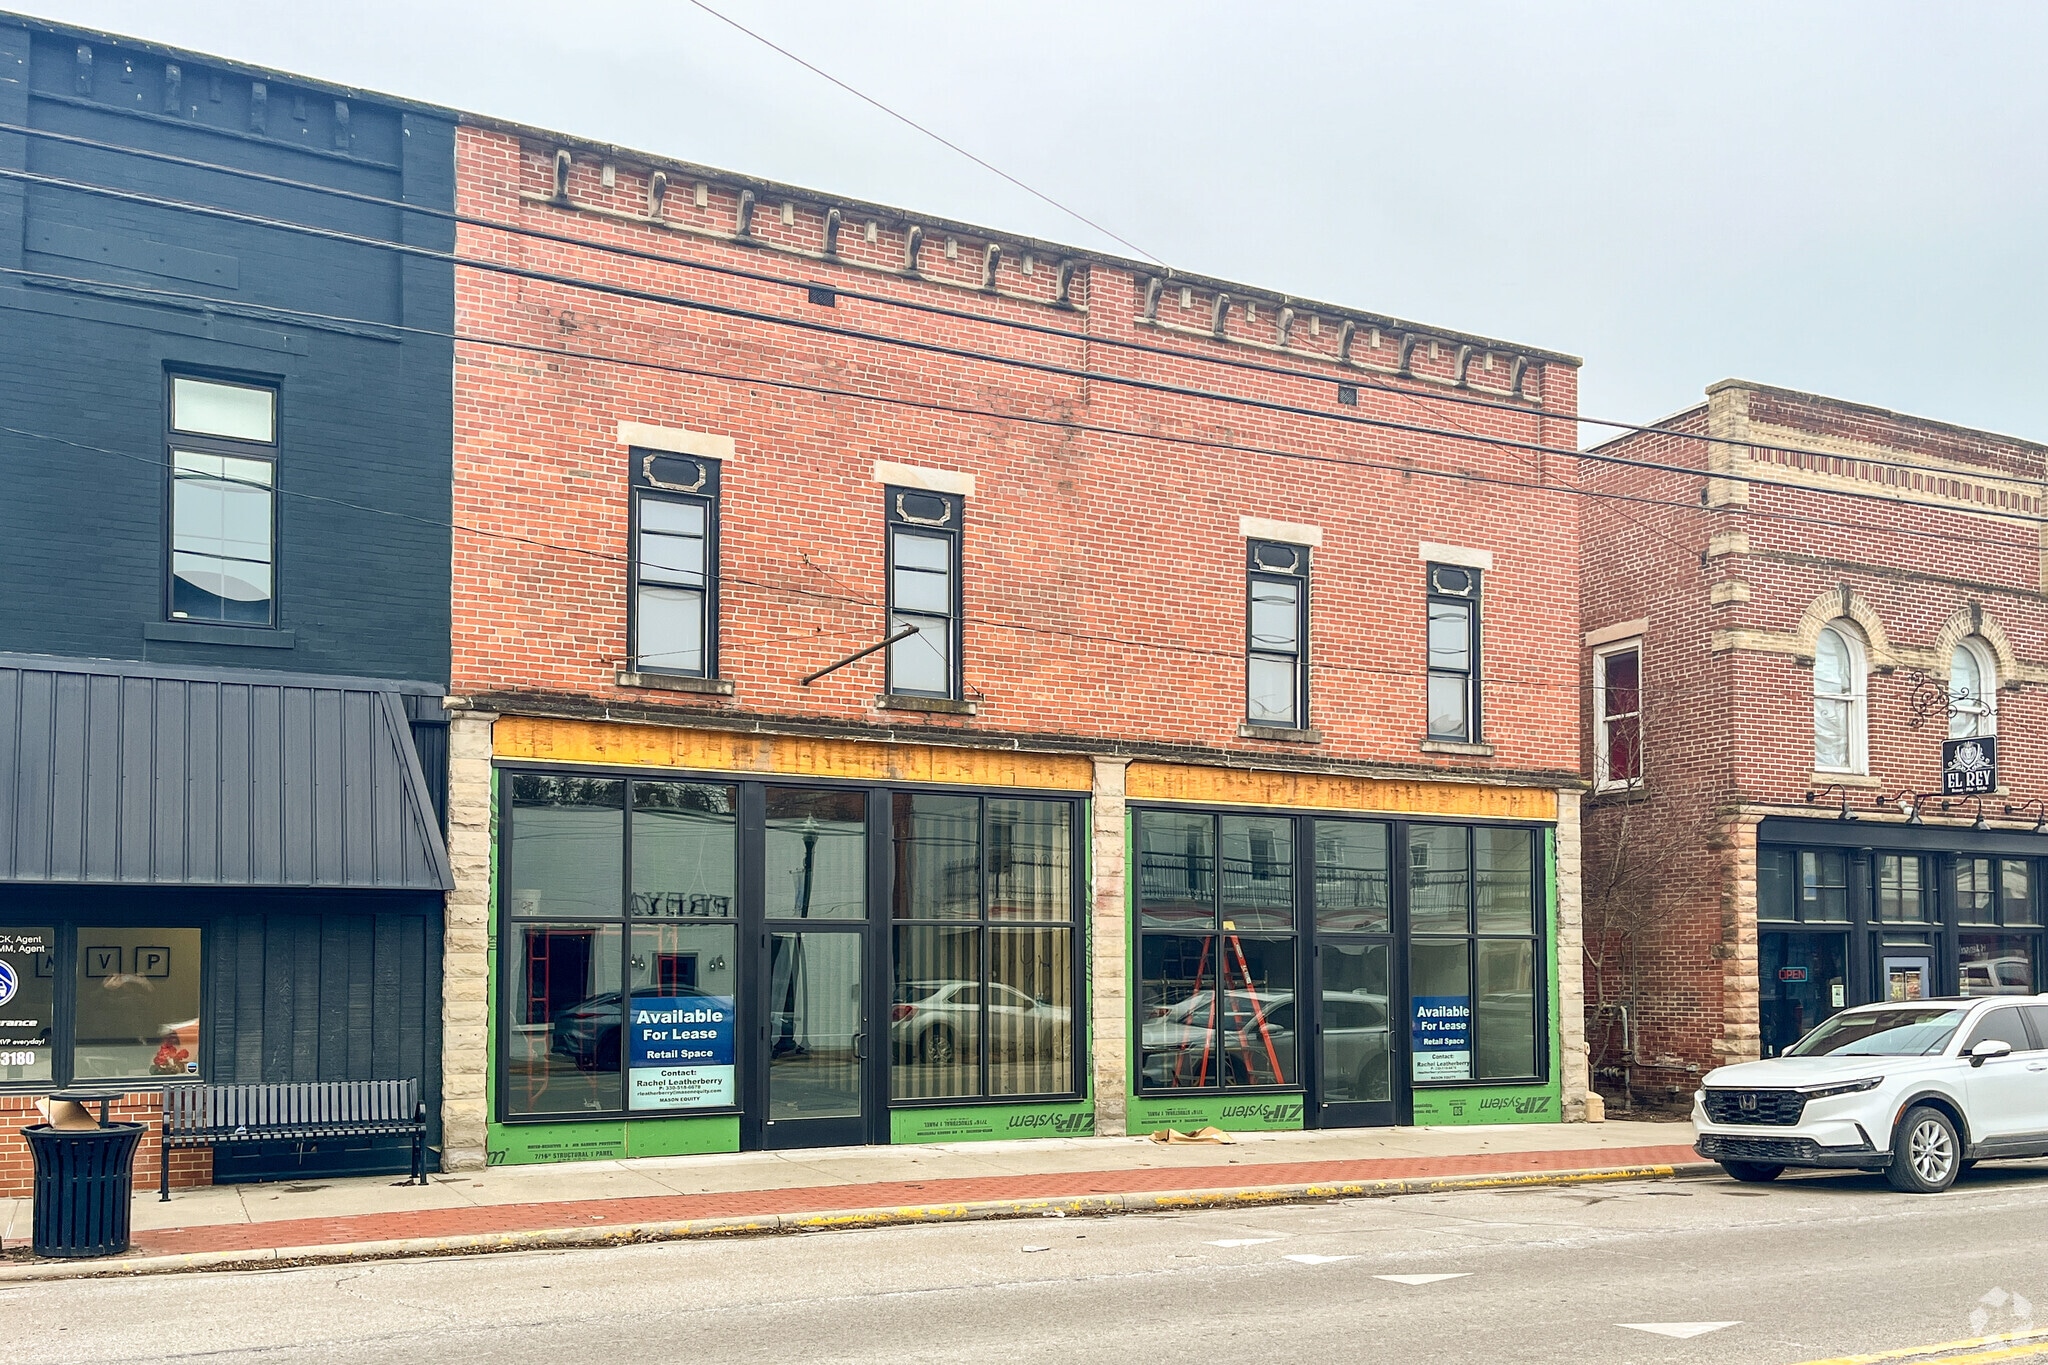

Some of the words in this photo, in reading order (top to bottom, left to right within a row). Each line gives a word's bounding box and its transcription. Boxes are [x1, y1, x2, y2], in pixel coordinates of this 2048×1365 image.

[1947, 773, 1963, 788] EL
[1966, 770, 1991, 787] REY
[15, 935, 42, 945] Agent
[18, 944, 46, 955] Agent
[1779, 970, 1806, 980] OPEN
[636, 1008, 724, 1025] Available
[1417, 1005, 1470, 1018] Available
[1421, 1021, 1437, 1031] For
[1439, 1020, 1467, 1031] Lease
[643, 1029, 668, 1041] For
[672, 1028, 718, 1040] Lease
[12, 1037, 46, 1047] everyday!
[1423, 1038, 1444, 1046] Retail
[1444, 1037, 1465, 1047] Space
[646, 1050, 678, 1060] Retail
[680, 1049, 714, 1060] Space
[661, 1069, 697, 1077] Contact:
[636, 1080, 667, 1088] Rachel
[668, 1078, 723, 1086] Leatherberry
[552, 1150, 589, 1159] STRUCTURAL
